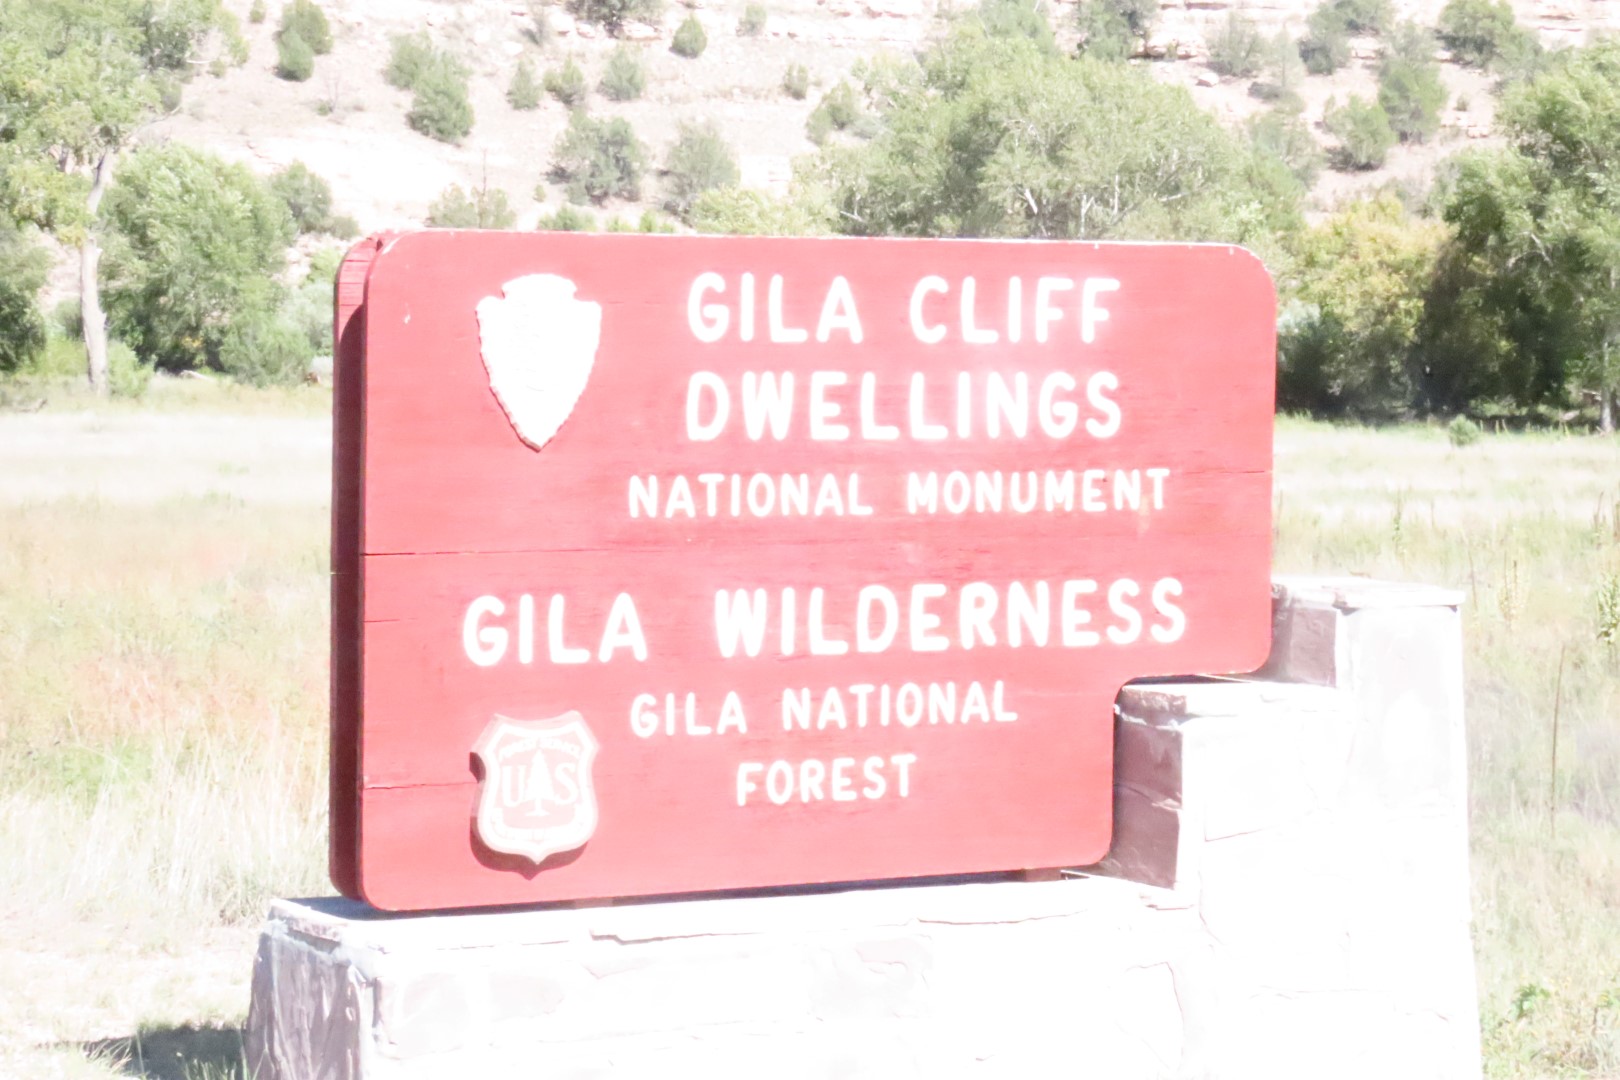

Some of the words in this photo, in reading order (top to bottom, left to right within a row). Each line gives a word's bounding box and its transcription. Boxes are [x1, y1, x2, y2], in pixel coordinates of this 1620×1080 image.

[687, 272, 864, 344] GILA
[909, 275, 1120, 346] CLIFF
[686, 368, 1121, 442] DWELLINGS
[629, 473, 873, 518] NATIONAL
[906, 468, 1170, 514] MONUMENT
[463, 593, 648, 666] GILA
[714, 577, 1186, 658] WILDERNESS
[630, 691, 747, 738] GILA
[782, 682, 1018, 730] NATIONAL
[736, 754, 917, 805] FOREST
